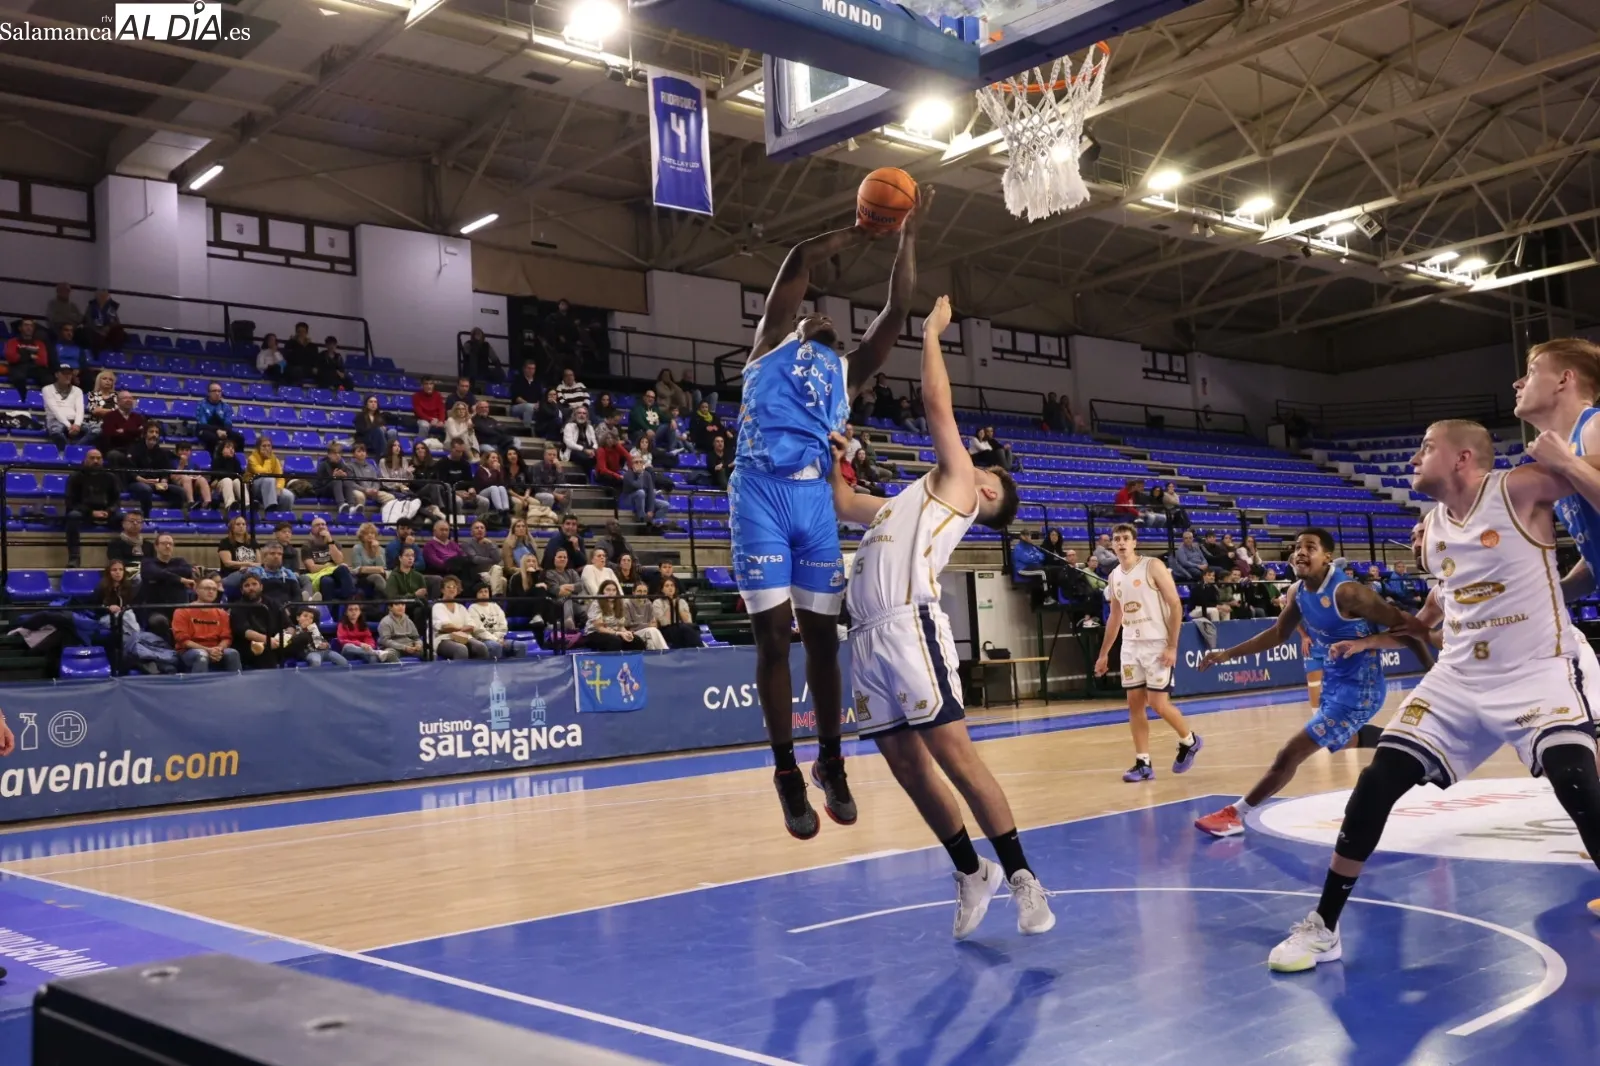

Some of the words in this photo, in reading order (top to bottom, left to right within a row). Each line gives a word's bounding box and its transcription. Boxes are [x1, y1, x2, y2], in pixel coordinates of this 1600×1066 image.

[822, 0, 882, 31] MONDO
[670, 112, 686, 154] 4
[855, 556, 865, 574] 5
[1490, 613, 1529, 627] RURAL
[1254, 653, 1260, 667] Y
[1218, 671, 1233, 682] NOS
[419, 718, 472, 735] turismo
[0, 750, 239, 798] avenida.com
